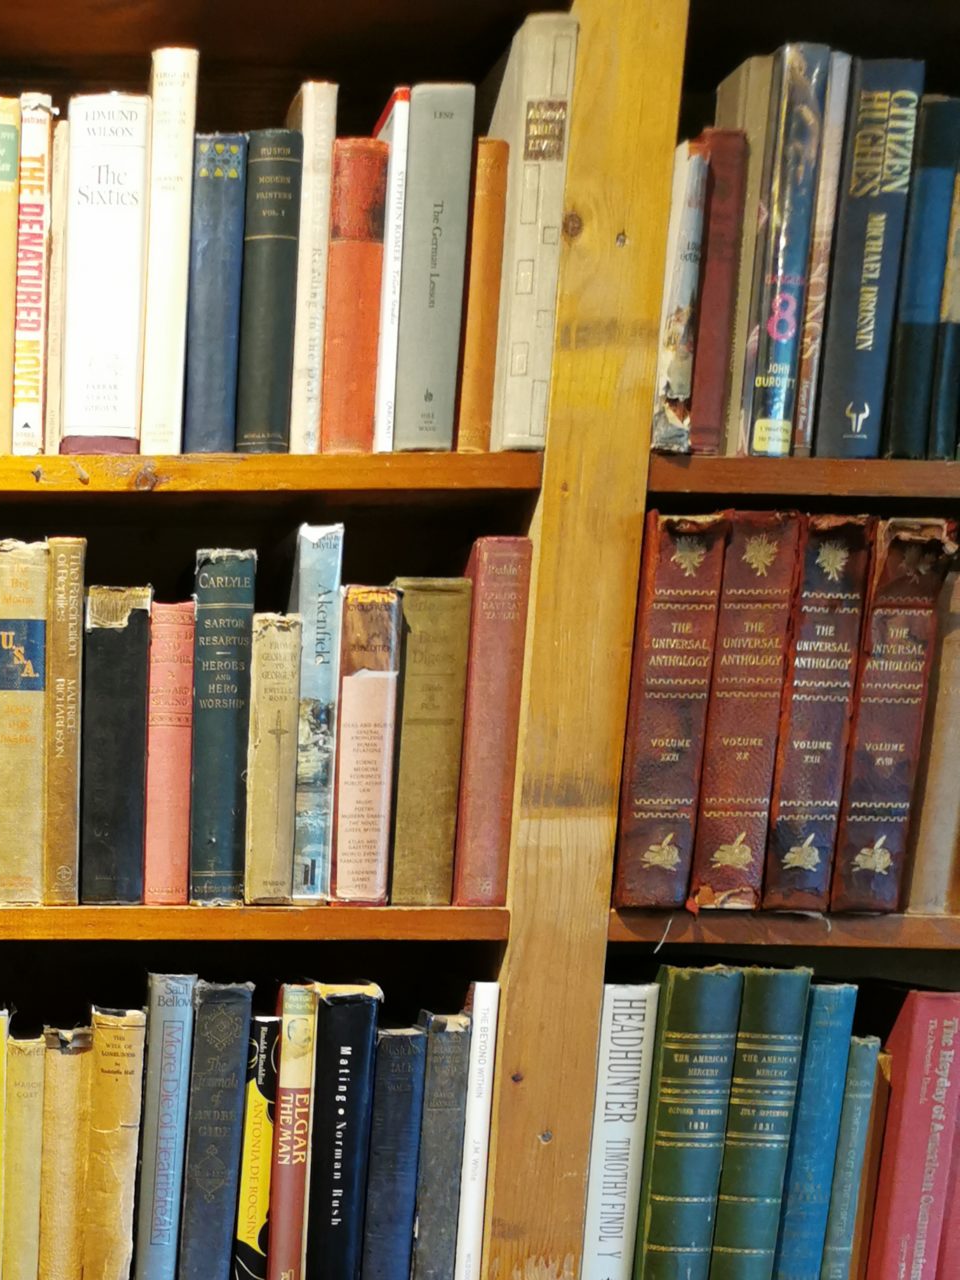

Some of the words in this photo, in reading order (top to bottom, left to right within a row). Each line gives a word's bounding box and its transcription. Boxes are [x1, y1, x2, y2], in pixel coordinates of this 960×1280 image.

[83, 110, 138, 123] EDMUND
[85, 126, 134, 138] WILSON
[881, 89, 919, 194] CITIZEN
[848, 90, 890, 198] HUGHES
[20, 154, 46, 196] THE
[90, 163, 128, 186] The
[77, 188, 140, 208] Sixties
[432, 201, 445, 224] The
[428, 226, 443, 270] German
[861, 213, 887, 282] MICHAEL
[16, 203, 47, 332] DENATURED
[427, 273, 441, 309] Lesson
[767, 292, 797, 342] 8
[855, 286, 879, 351] DROSNIN
[198, 572, 252, 589] CARLYLE
[204, 619, 245, 629] SARTOR
[314, 583, 333, 665] Akenfield
[671, 622, 693, 634] THE
[744, 622, 765, 634] THE
[815, 625, 835, 637] THE
[889, 628, 909, 639] THE
[199, 636, 249, 646] RESARTUS
[651, 638, 709, 651] UNIVERSAL
[723, 636, 782, 650] UNIVERSAL
[796, 641, 851, 653] UNIVERSAL
[202, 661, 245, 671] HEROES
[648, 655, 709, 668] ANTHOLOGY
[720, 654, 782, 668] ANTHOLOGY
[794, 657, 852, 670] ANTHOLOGY
[865, 660, 925, 672] ANTHOLOGY
[208, 684, 238, 694] HERO
[164, 982, 188, 995] Saul
[157, 994, 192, 1008] Bellow
[940, 1018, 958, 1047] The
[477, 1026, 490, 1065] BEYOND
[692, 1055, 728, 1063] AMERICAN
[335, 1046, 352, 1102] Mating
[475, 1067, 486, 1098] WITHIN
[931, 1049, 954, 1104] Heyday
[279, 1093, 294, 1127] THE
[931, 1105, 947, 1121] of
[292, 1093, 310, 1165] ELGAR
[277, 1127, 293, 1165] MAN
[333, 1121, 347, 1180] Norman
[330, 1189, 344, 1226] Rush
